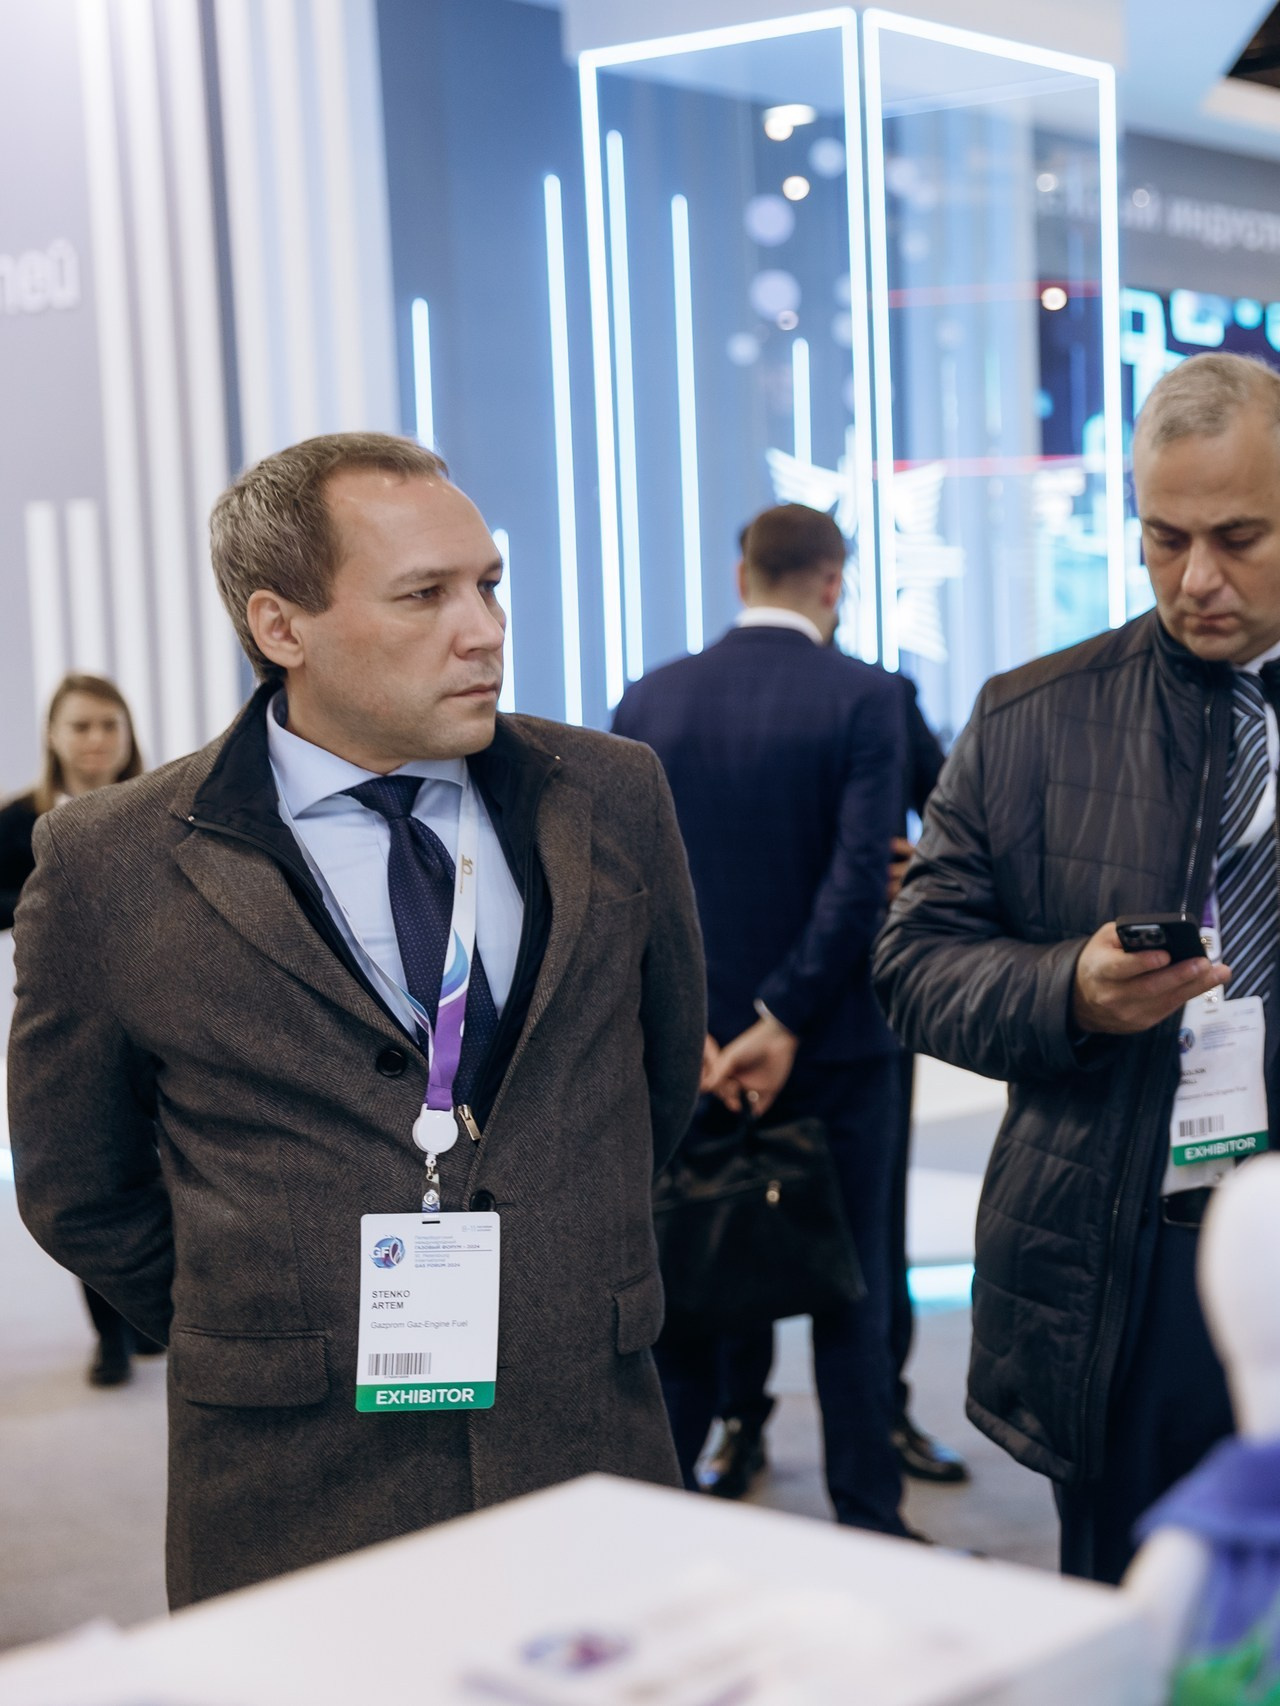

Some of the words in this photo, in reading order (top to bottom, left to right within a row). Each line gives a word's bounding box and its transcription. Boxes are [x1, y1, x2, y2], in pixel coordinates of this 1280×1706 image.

[1184, 1136, 1257, 1161] EXHIBITOR
[372, 1290, 411, 1299] STENKO
[371, 1301, 404, 1310] ARTEM
[370, 1321, 406, 1330] Gazprom
[451, 1319, 469, 1328] Fuel
[375, 1388, 475, 1405] EXHIBITOR
